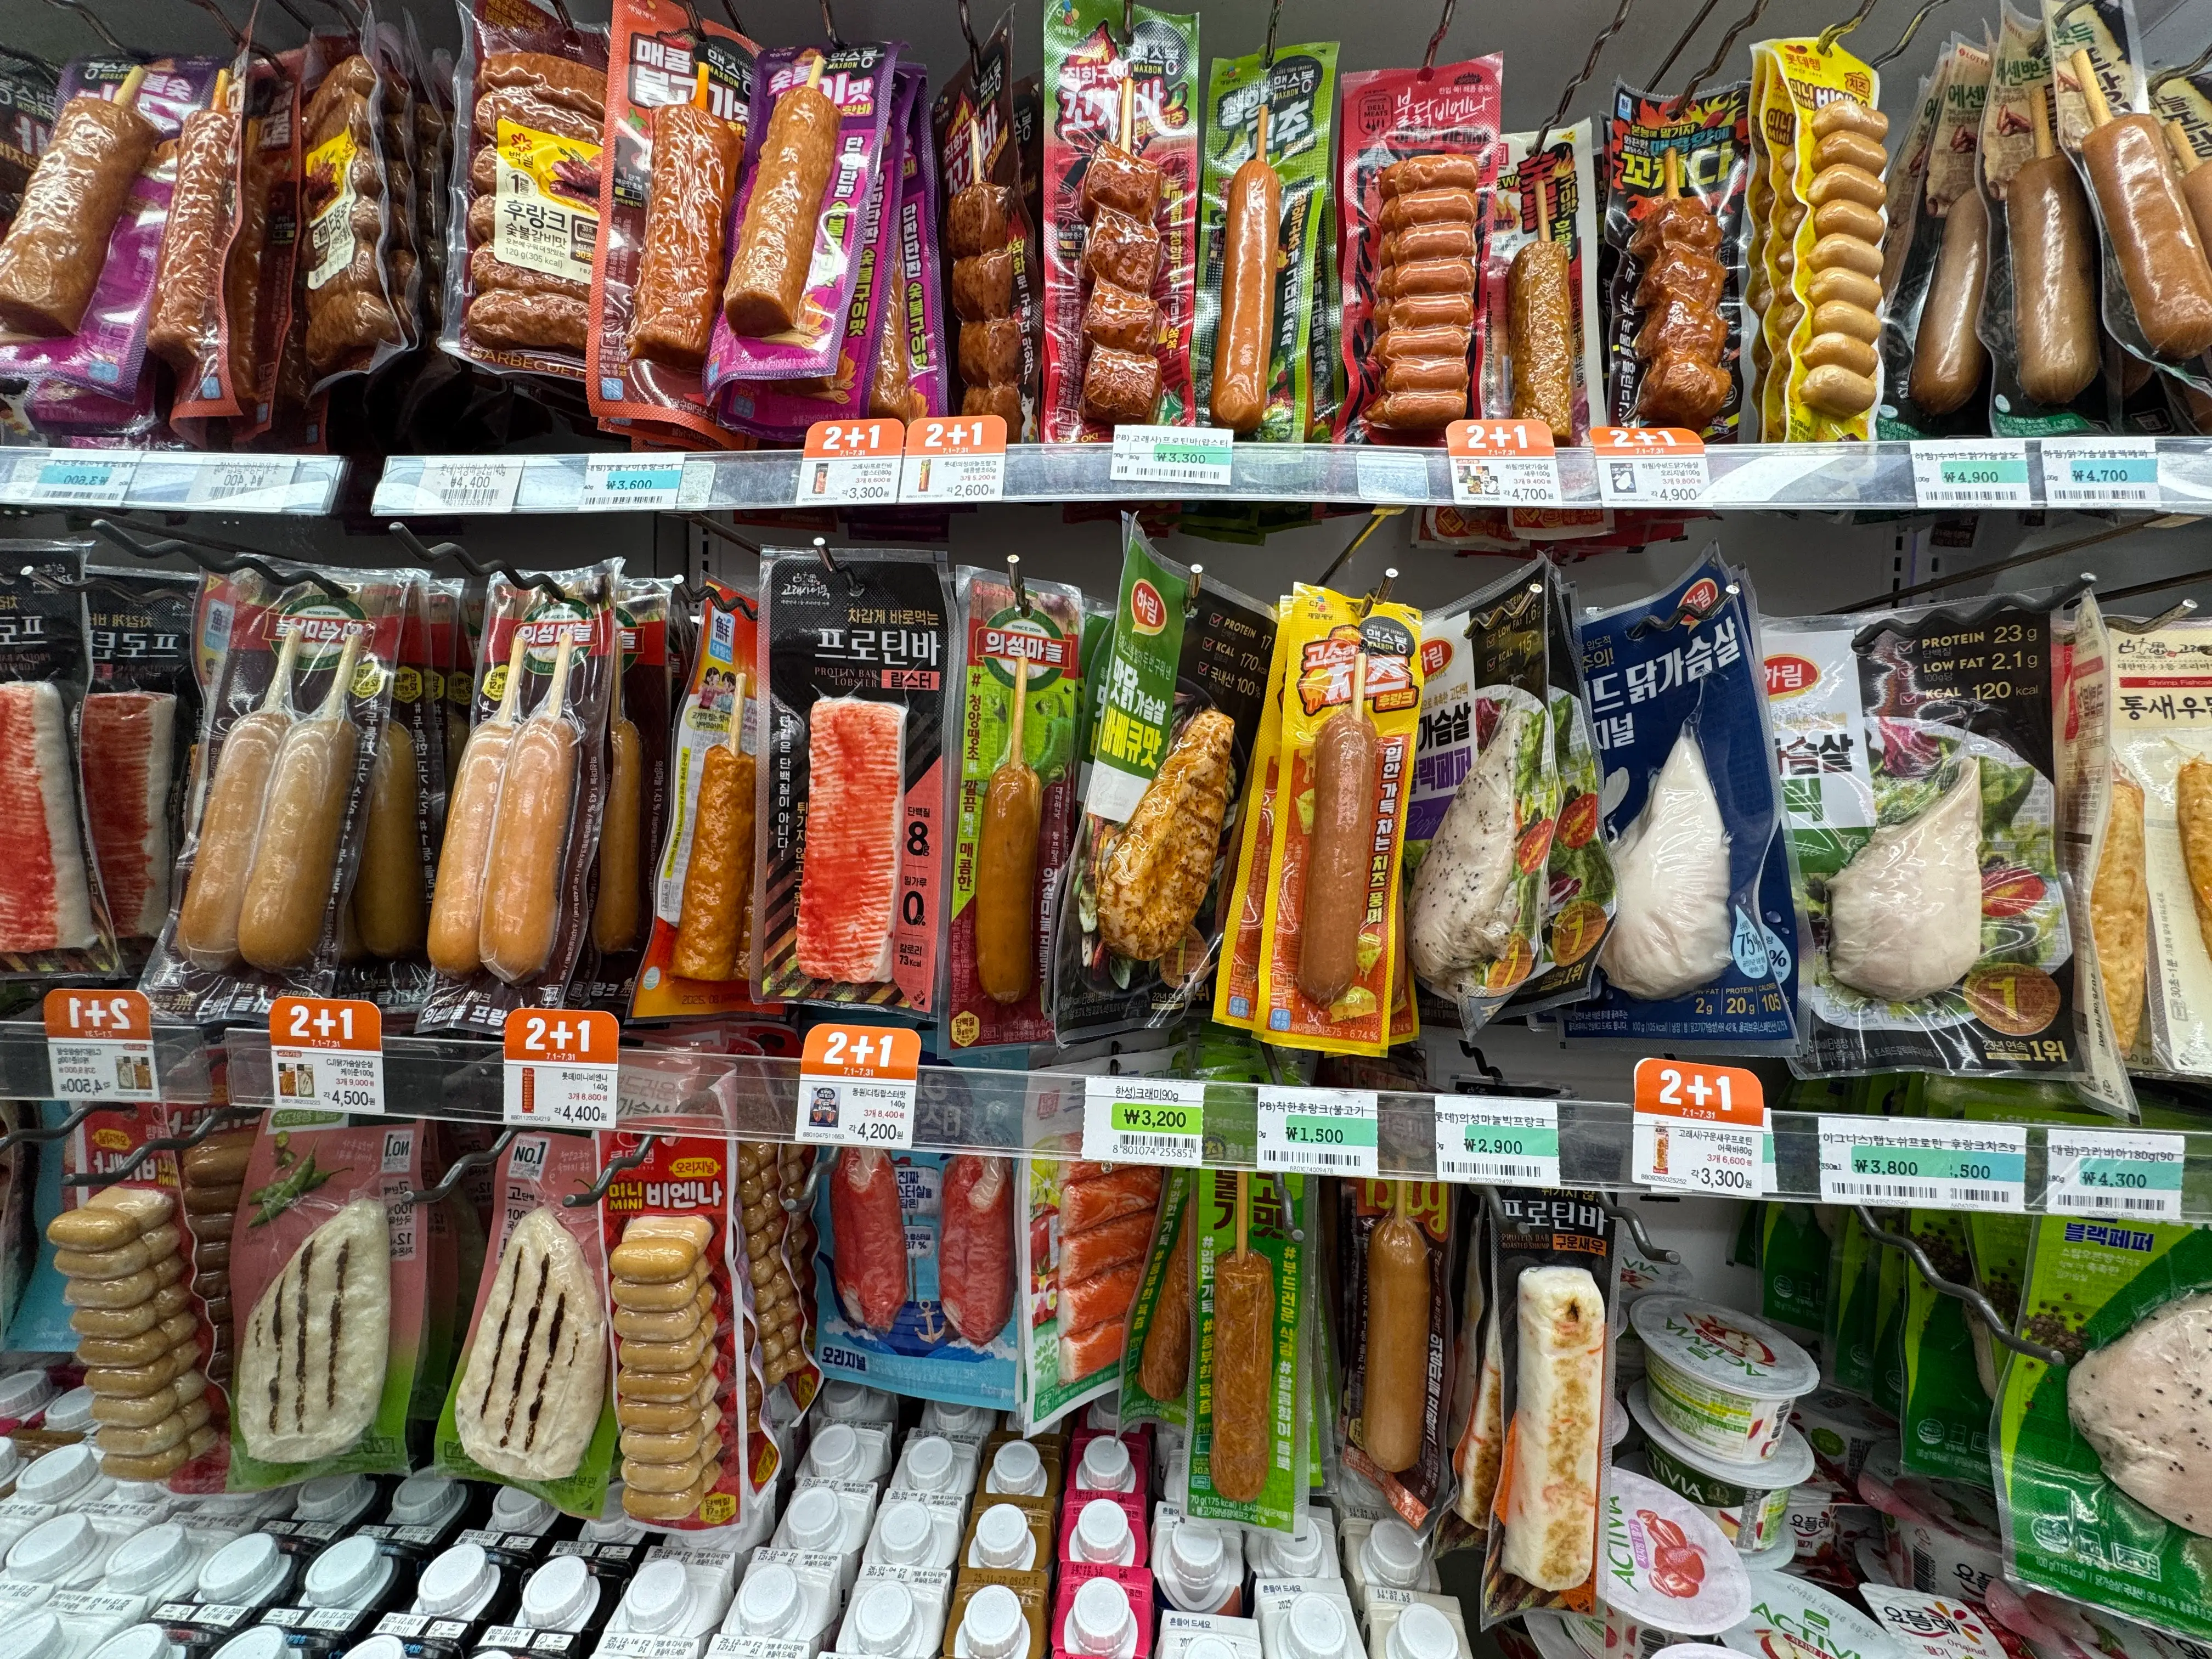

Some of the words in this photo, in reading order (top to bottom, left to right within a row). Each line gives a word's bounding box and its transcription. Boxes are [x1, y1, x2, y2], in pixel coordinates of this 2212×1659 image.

[636, 39, 691, 74] 매콤
[828, 61, 857, 70] MAXBON
[830, 50, 878, 69] 맥스봉
[1965, 50, 1989, 67] LOTTE
[1134, 64, 1163, 75] MAXBON
[1273, 69, 1314, 93] 맥스봉
[1849, 78, 1866, 94] 치즈
[1767, 110, 1791, 130] 미니
[1768, 131, 1791, 145] MINI
[509, 151, 533, 169] 백설
[504, 200, 568, 234] 후랑크
[505, 222, 567, 249] 숯불갈비맛
[505, 247, 519, 257] 120
[545, 255, 563, 268] kcal)
[822, 424, 881, 450] 2+1
[924, 422, 983, 448] 2+1
[1466, 425, 1527, 448] 2+1
[1609, 430, 1678, 447] 2+1
[450, 476, 490, 490] ₩4,400
[1137, 588, 1157, 624] 하림
[847, 608, 885, 624] 차갑게
[890, 610, 940, 627] 바로먹는
[1224, 618, 1257, 639] PROTEIN
[1922, 631, 1985, 649] PROTEIN
[1994, 625, 2022, 644] 23
[814, 627, 941, 667] 프로틴바
[985, 631, 1064, 664] 의성마늘
[1216, 641, 1235, 657] KCAL
[1498, 646, 1514, 663] KCAL
[1624, 616, 1741, 705] 닭가슴살
[1923, 659, 1954, 674] LOW
[1960, 656, 1985, 670] FAT
[1991, 651, 2023, 670] 2.1
[815, 667, 857, 678] PROTEIN
[859, 668, 878, 678] BAR
[890, 672, 932, 690] 랍스터
[1210, 666, 1235, 687] 국내산
[1763, 664, 1803, 688] 하림
[834, 678, 878, 688] LOBSTER
[1925, 687, 1962, 699] KCAL
[1972, 681, 2011, 701] 120
[2015, 685, 2039, 697] kcal
[1379, 692, 1415, 707] 후랑크
[1102, 706, 1163, 771] 바베큐맛
[1381, 744, 1404, 779] 입안
[1379, 782, 1398, 815] 가득
[907, 806, 931, 818] 단백질
[777, 811, 789, 861] 아니다!
[1373, 819, 1393, 851] 차는
[956, 842, 974, 892] 매콤한
[1370, 856, 1389, 888] 치즈
[904, 876, 928, 888] 밀가루
[899, 943, 923, 956] 칼로리
[899, 955, 909, 966] 73
[910, 958, 922, 968] Kcal
[1762, 994, 1781, 1013] 105
[290, 1005, 353, 1040] 2+1
[525, 1018, 591, 1053] 2+1
[823, 1031, 893, 1068] 2+1
[2030, 1039, 2067, 1063] 1위
[592, 1084, 608, 1093] 140g
[1115, 1085, 1178, 1102] 한성)크래미90g
[1660, 1069, 1732, 1111] 2+1
[890, 1100, 905, 1109] 140g
[1124, 1108, 1187, 1128] ₩3,200
[1286, 1126, 1344, 1144] ₩1,500
[514, 1141, 545, 1163] NO.1
[1113, 1145, 1118, 1153] 8
[1120, 1145, 1156, 1156] 801074
[1463, 1138, 1523, 1155] ₩2,900
[675, 1160, 715, 1175] 오리지널
[1854, 1159, 1918, 1176] ₩3,800
[898, 1171, 919, 1185] 진짜
[608, 1182, 643, 1199] 미니
[646, 1182, 723, 1208] 비엔나
[609, 1198, 643, 1211] MINI
[1502, 1199, 1609, 1236] 프로틴바
[1555, 1235, 1605, 1252] 구운새우
[2063, 1222, 2155, 1253] 블랙페퍼
[821, 1346, 867, 1372] 오리지널
[1190, 1495, 1200, 1503] 70
